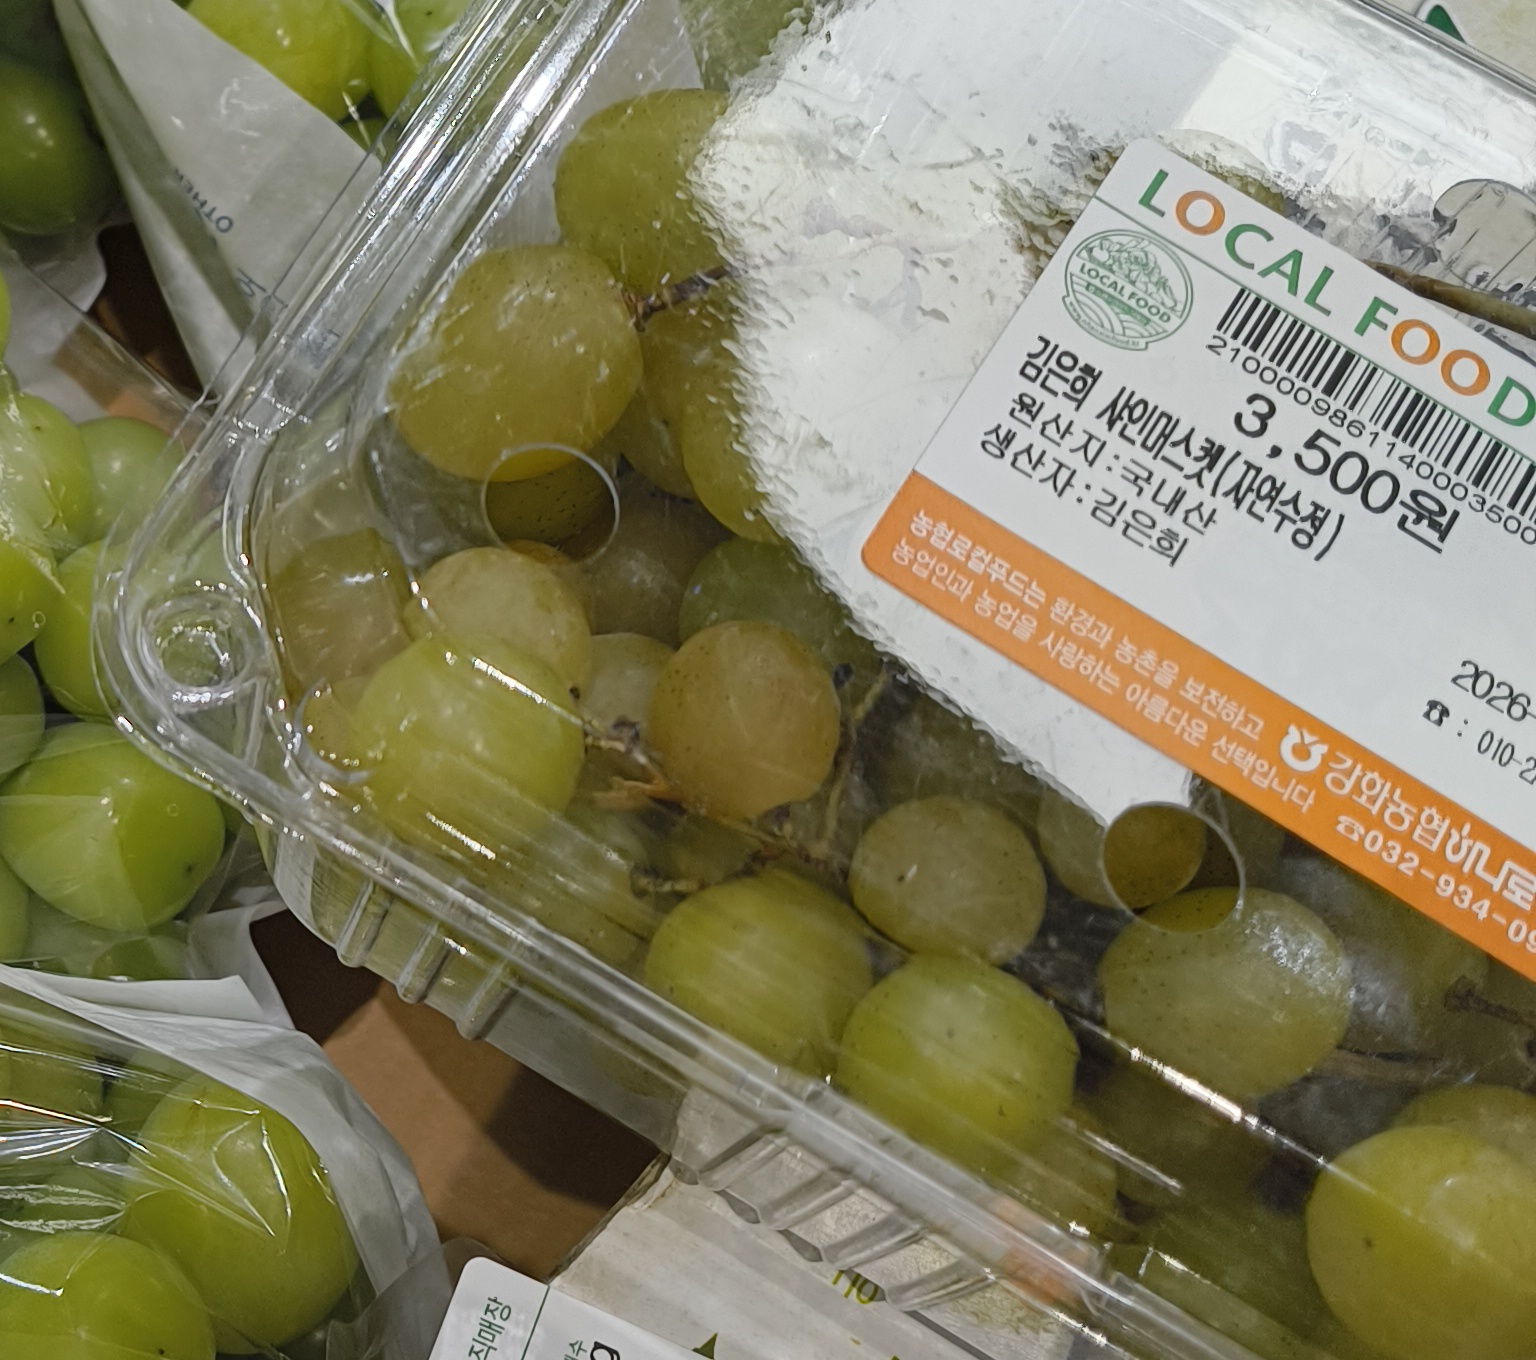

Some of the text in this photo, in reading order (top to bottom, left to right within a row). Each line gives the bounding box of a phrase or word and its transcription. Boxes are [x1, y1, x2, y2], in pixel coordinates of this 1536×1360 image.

[1079, 262, 1127, 302] LOCAL
[1128, 292, 1172, 326] FOOD
[1138, 168, 1536, 428] LOCAL FOOD
[1019, 335, 1345, 561] 김은희 샤인머스켓(자연수정)
[1233, 392, 1461, 554] 3,500원
[892, 537, 1316, 815] 농업인과 농업을 사랑하는 아름다운 선택입니다
[909, 507, 1265, 741] 농협로컬푸드는 환경과 농촌을 보전하고
[1450, 659, 1536, 722] 2026-
